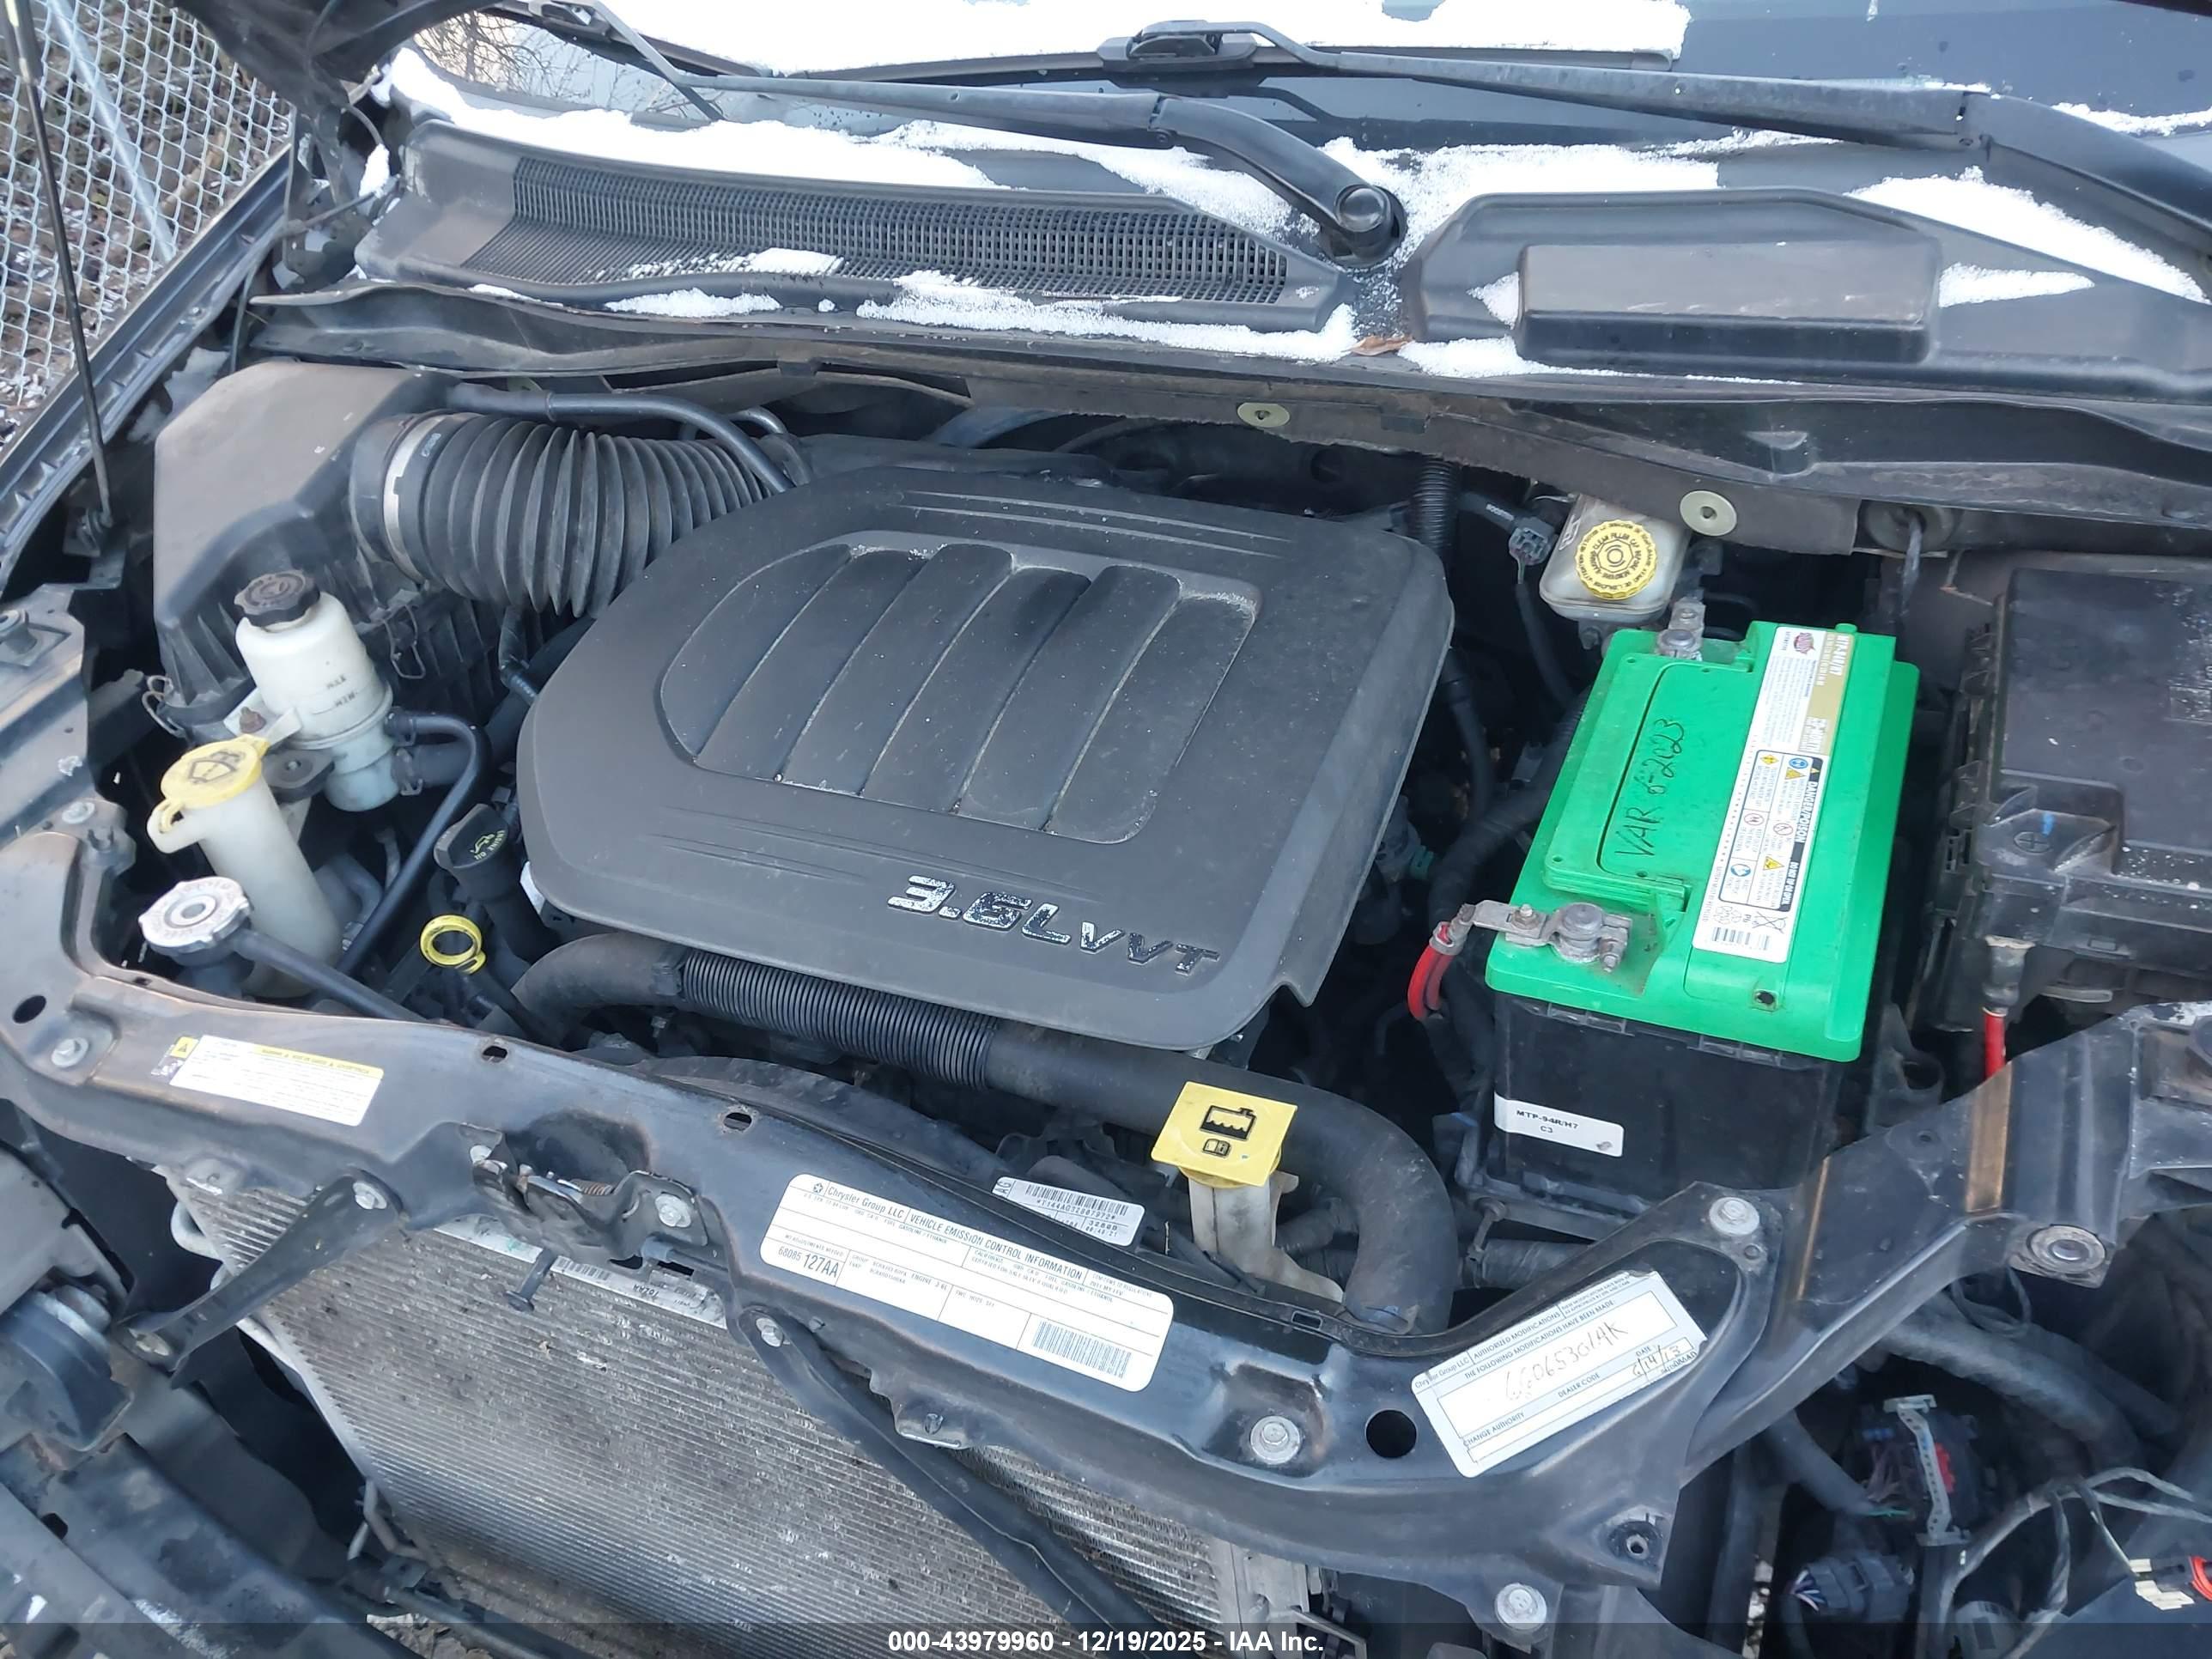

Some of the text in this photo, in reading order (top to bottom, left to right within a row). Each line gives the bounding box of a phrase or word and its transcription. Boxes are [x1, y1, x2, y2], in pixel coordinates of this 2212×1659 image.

[1796, 783, 1817, 840] DANGER/POISON
[474, 851, 486, 860] OIL
[828, 1187, 860, 1205] Chrysler
[861, 1198, 885, 1213] Group
[888, 1206, 904, 1218] LLC
[778, 1246, 800, 1261] 68085
[910, 1213, 1081, 1279] VEHICLE EMISSION CONTROL INFORMATION
[803, 1254, 838, 1277] 127AA
[1464, 1369, 1476, 1379] THE
[1477, 1350, 1512, 1373] FOLLOWING
[1515, 1325, 1561, 1355] MODIFICATIONS
[1562, 1317, 1578, 1329] HAVE
[1579, 1309, 1595, 1321] BEEN
[1474, 1310, 1559, 1359] AUTHORIZED MODIFICATIONS
[1636, 1346, 1651, 1358] DATE
[1438, 1363, 1456, 1377] Group
[1456, 1357, 1469, 1367] LLC
[1559, 1372, 1599, 1398] DEALER CODE
[1463, 1412, 1523, 1446] CHANGE AUTHORITY
